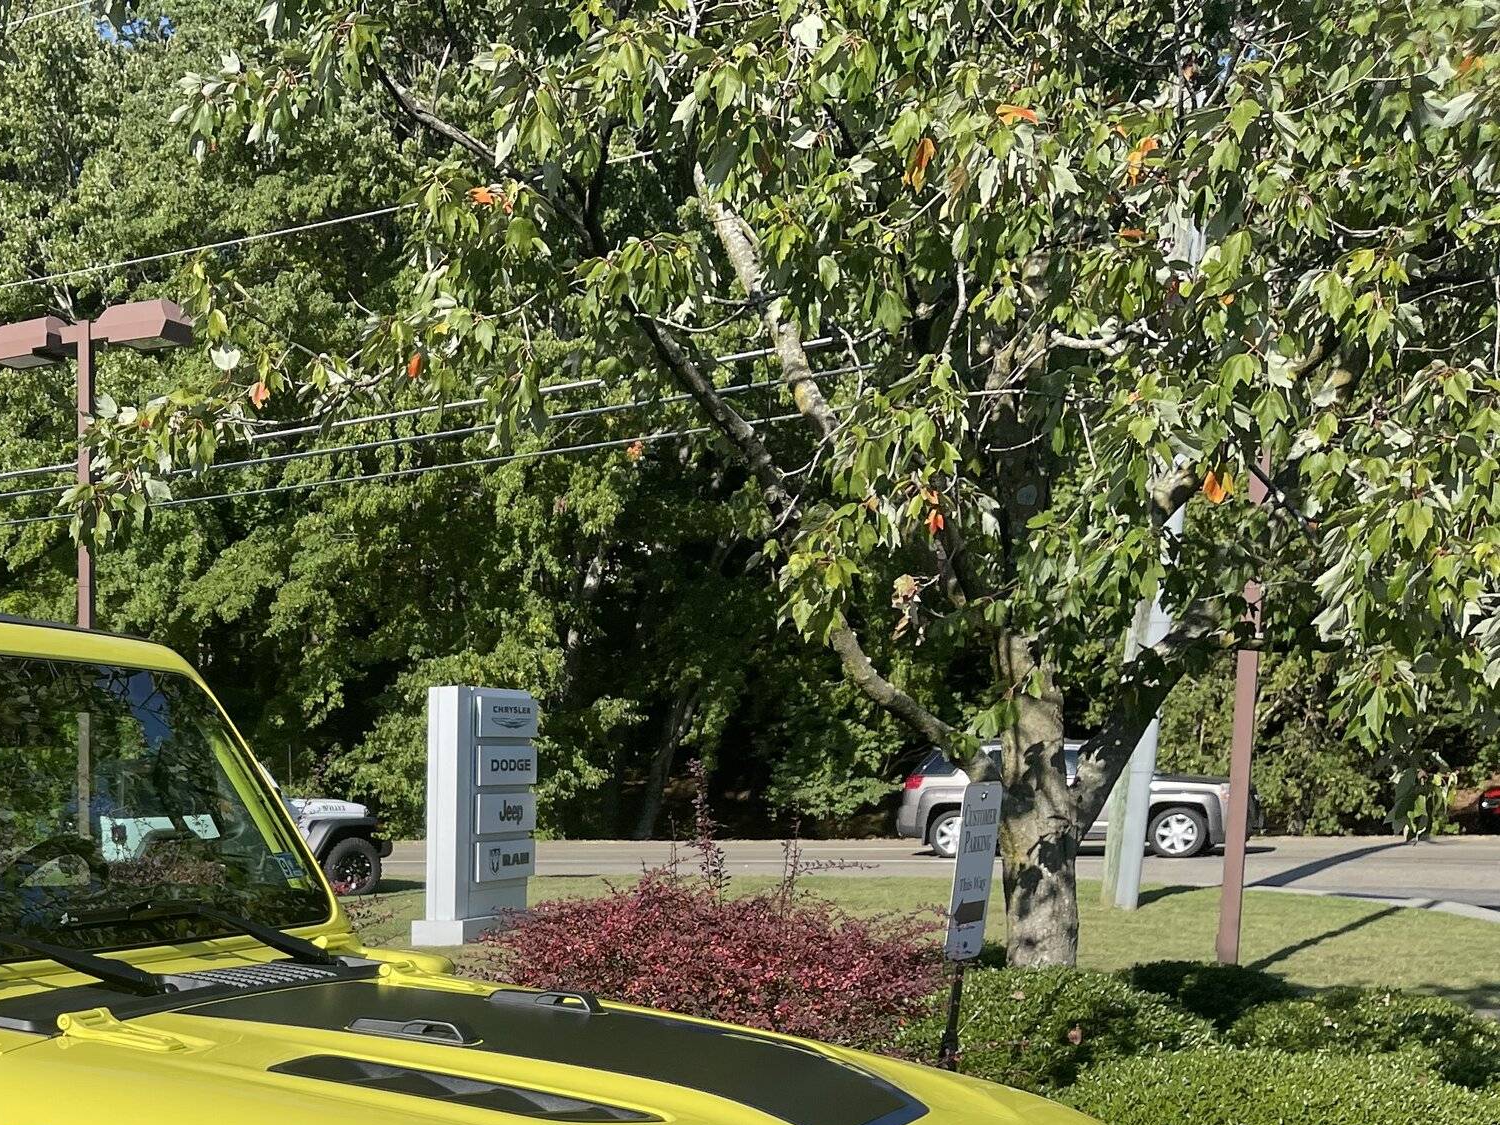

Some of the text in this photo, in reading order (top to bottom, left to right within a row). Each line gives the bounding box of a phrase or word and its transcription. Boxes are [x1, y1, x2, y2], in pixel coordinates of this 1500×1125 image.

[492, 705, 531, 715] CHRYSLER
[491, 759, 531, 772] DODGE
[499, 799, 524, 825] Jeep
[965, 804, 997, 827] CUSTOMER
[965, 831, 992, 853] PARKING
[502, 851, 530, 867] RAM
[959, 877, 987, 892] This Way
